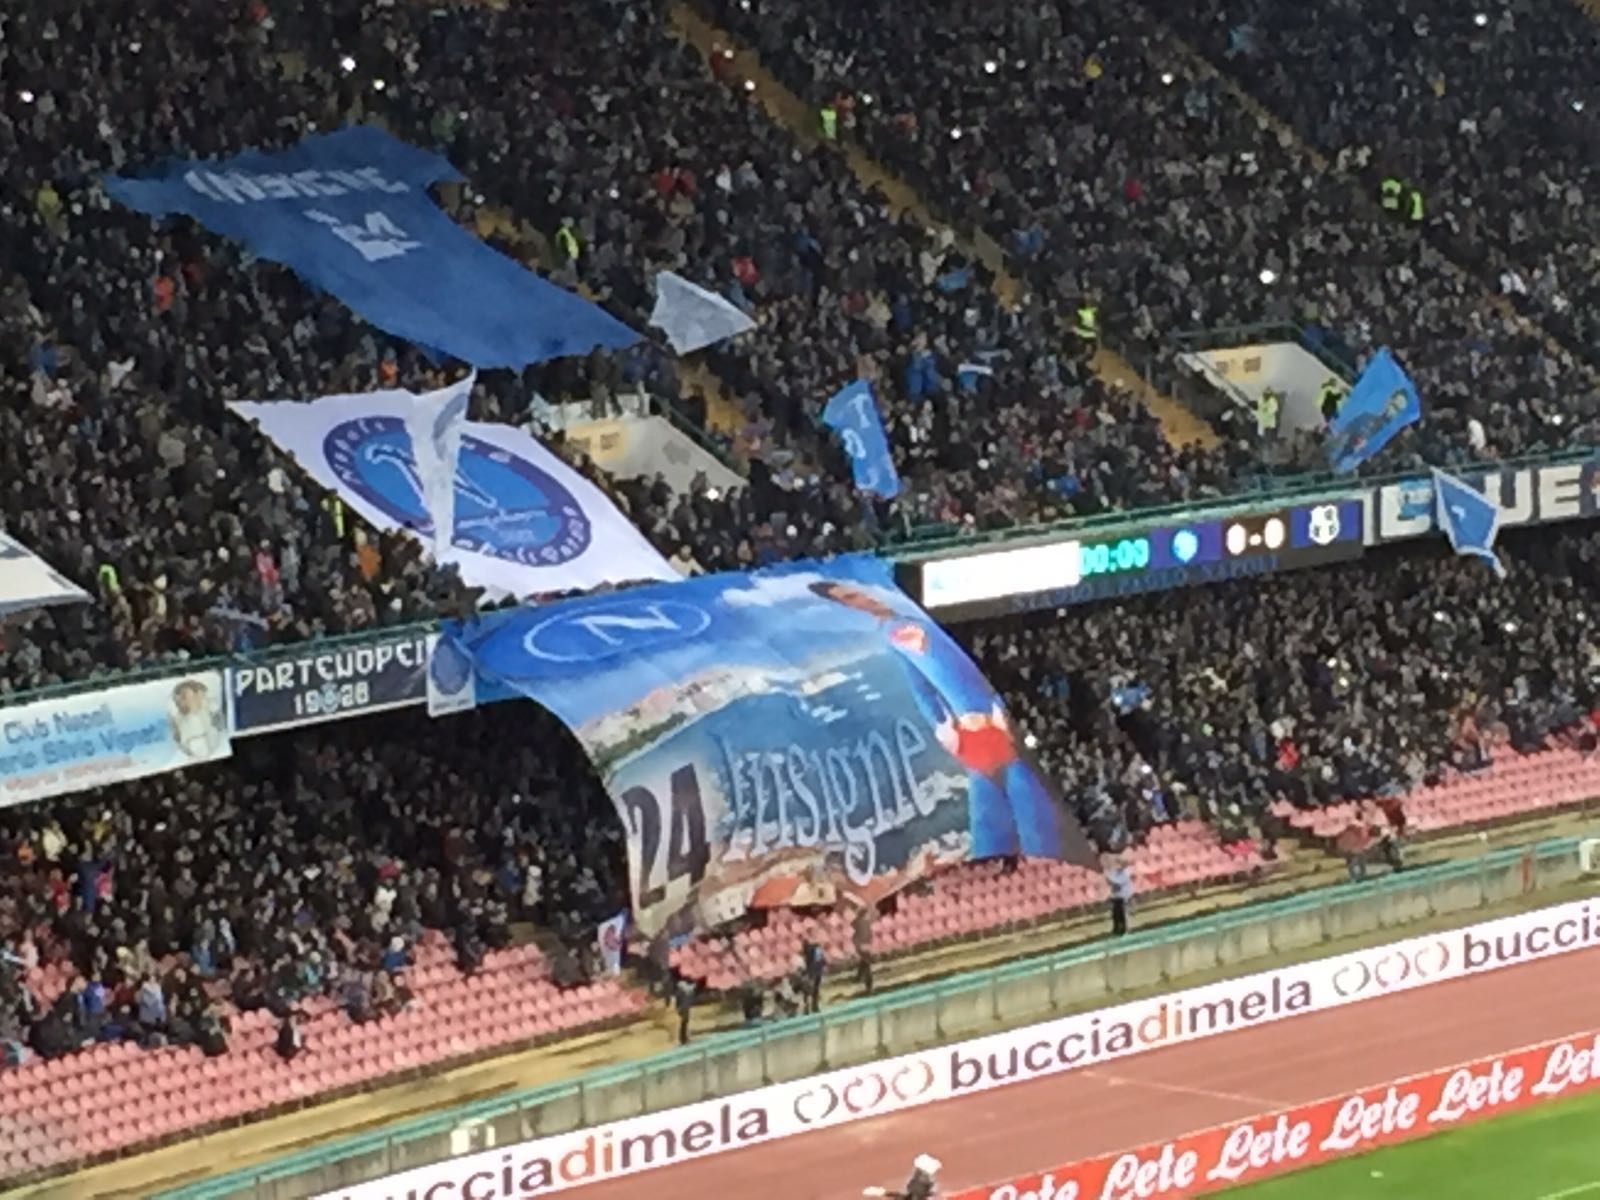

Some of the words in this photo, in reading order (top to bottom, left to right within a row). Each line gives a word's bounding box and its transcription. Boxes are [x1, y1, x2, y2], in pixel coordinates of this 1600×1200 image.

[620, 763, 711, 908] 24
[1463, 906, 1600, 969] bucci
[950, 976, 1312, 1090] bucciadimela
[1319, 1085, 1421, 1152] Lete
[1426, 1060, 1525, 1123] Lete
[1207, 1115, 1312, 1182] Lete
